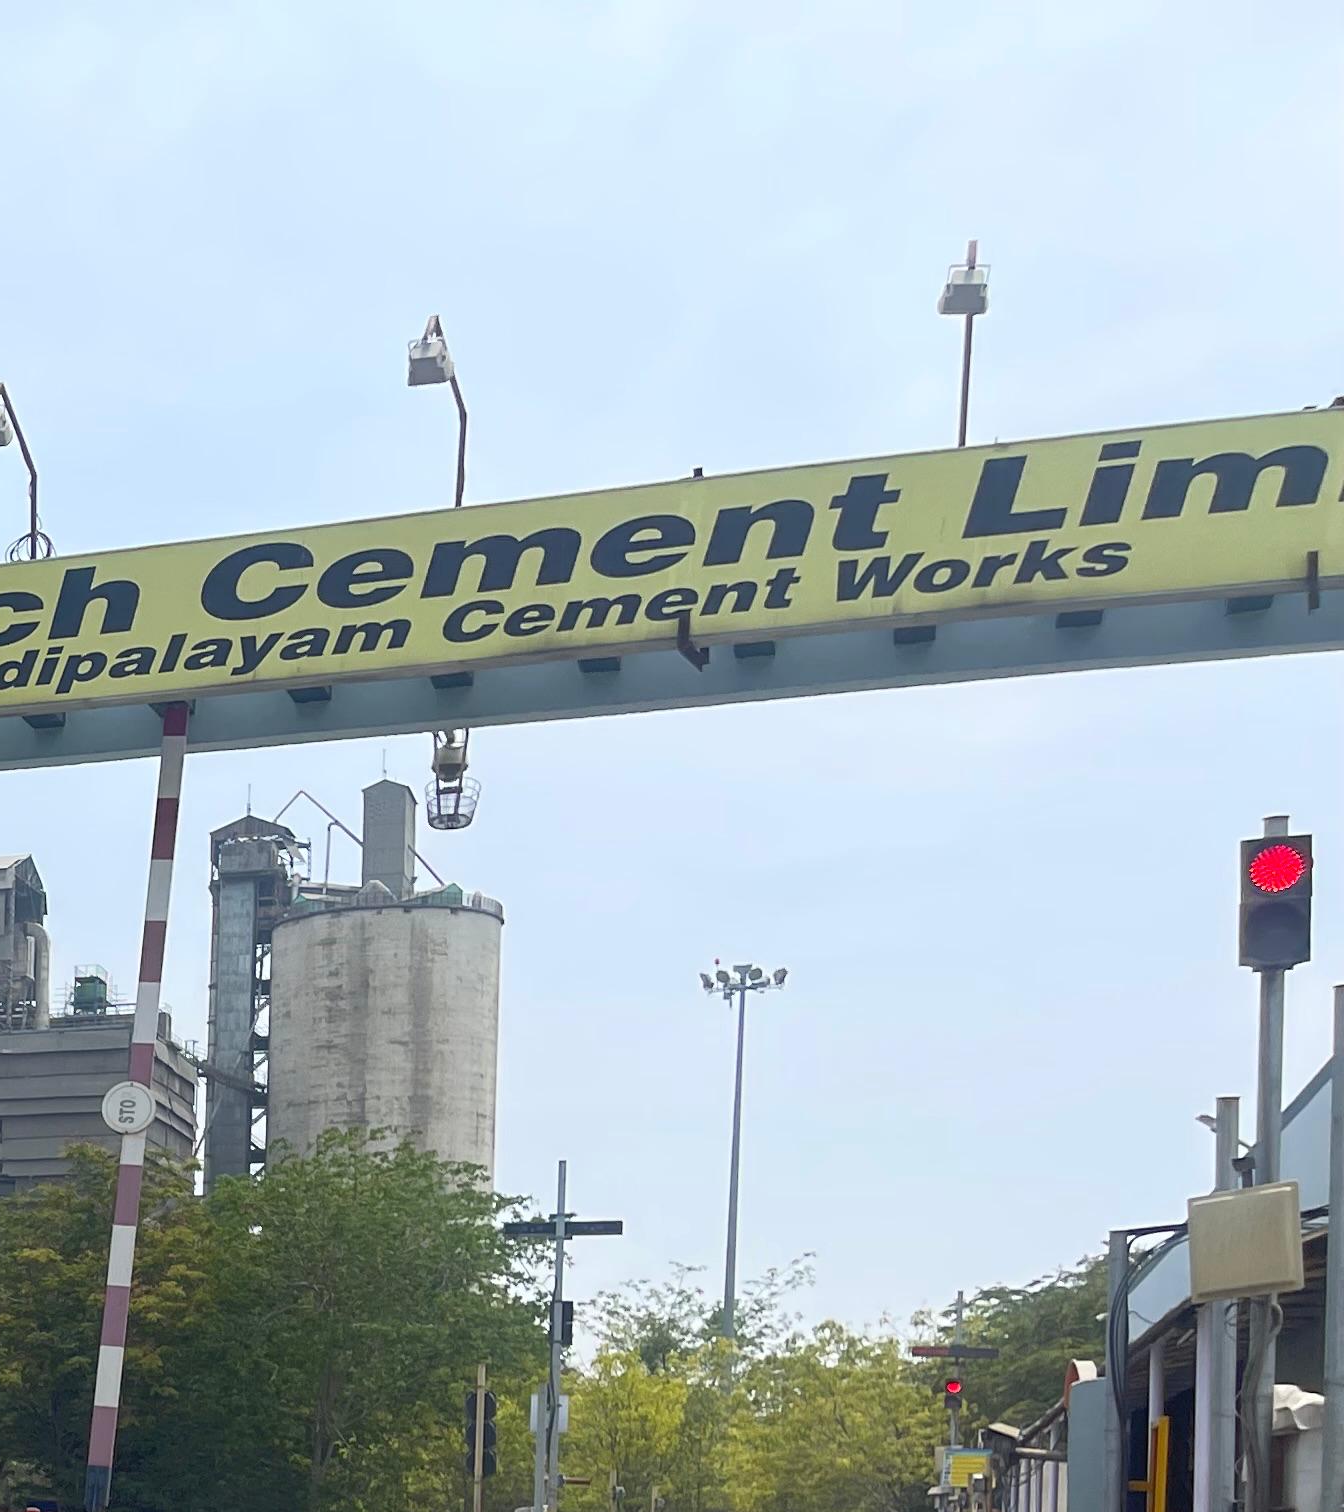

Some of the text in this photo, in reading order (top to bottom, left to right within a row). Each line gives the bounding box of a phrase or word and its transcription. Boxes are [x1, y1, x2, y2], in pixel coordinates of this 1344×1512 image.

[200, 472, 902, 622] Cement
[961, 439, 1343, 539] Lim
[442, 566, 801, 644] Cement
[835, 538, 1133, 602] Works
